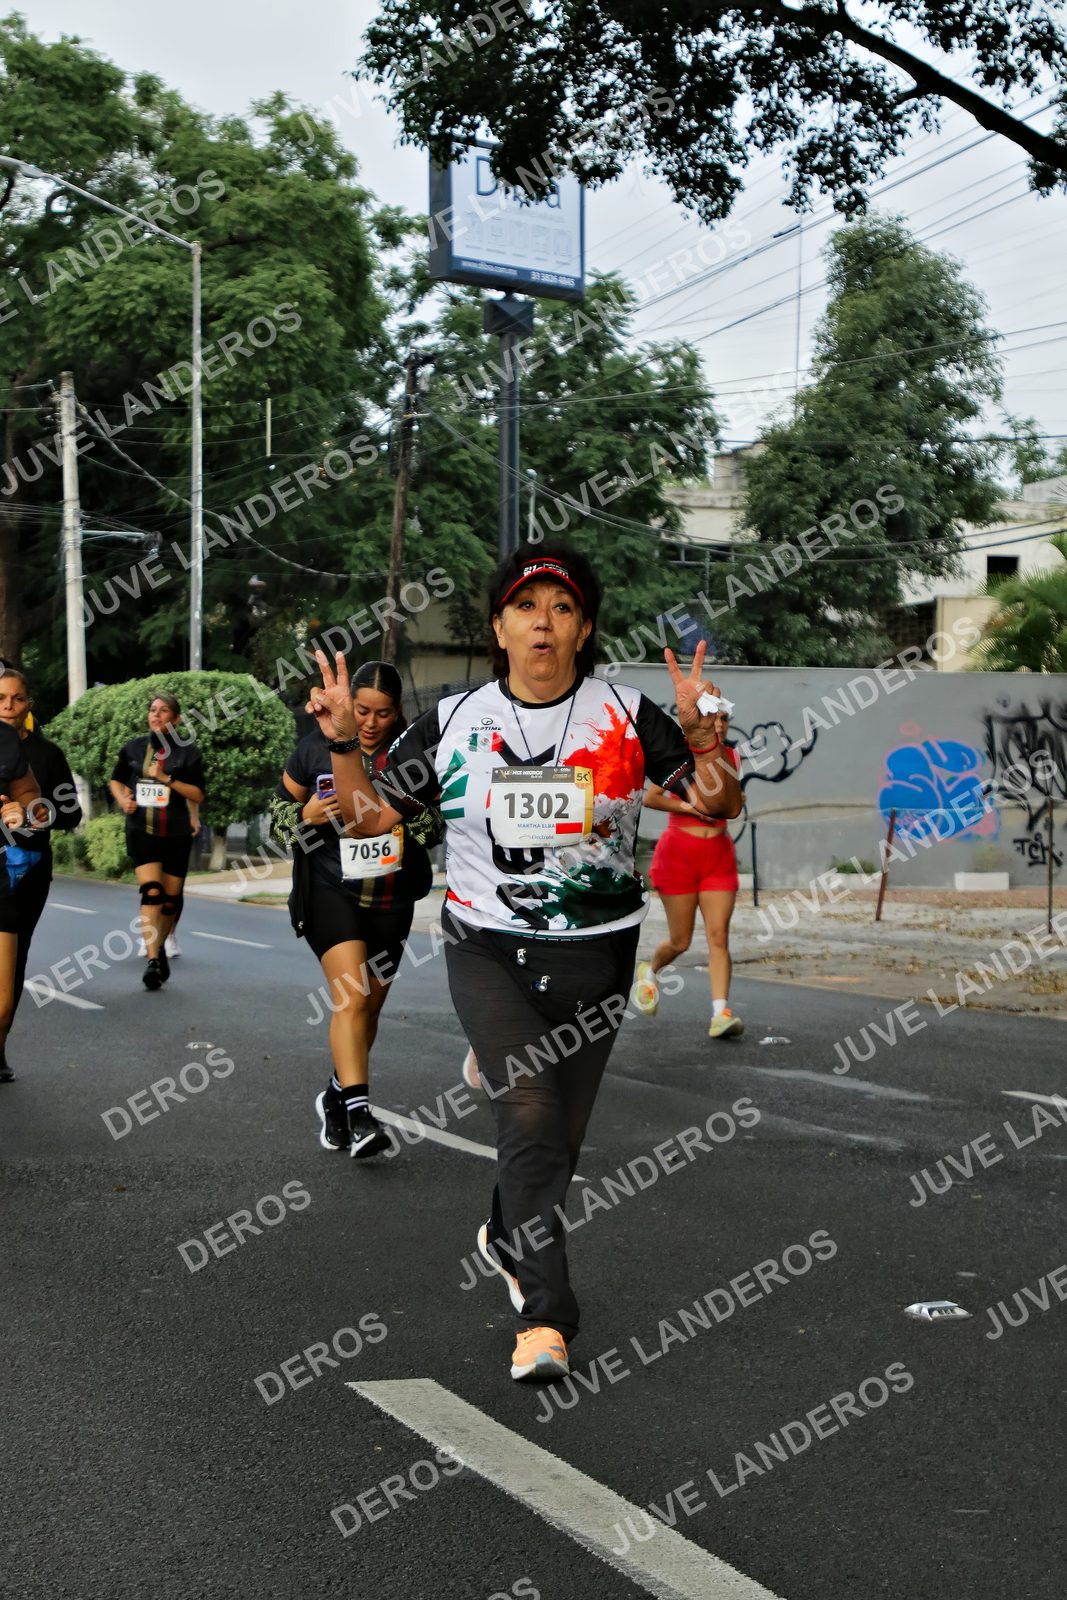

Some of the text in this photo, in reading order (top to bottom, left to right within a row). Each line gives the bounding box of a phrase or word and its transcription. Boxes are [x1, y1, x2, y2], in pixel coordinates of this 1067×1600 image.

[576, 773, 589, 782] 5K
[141, 787, 164, 797] 5718
[503, 792, 570, 819] 1302
[349, 840, 392, 861] 7056
